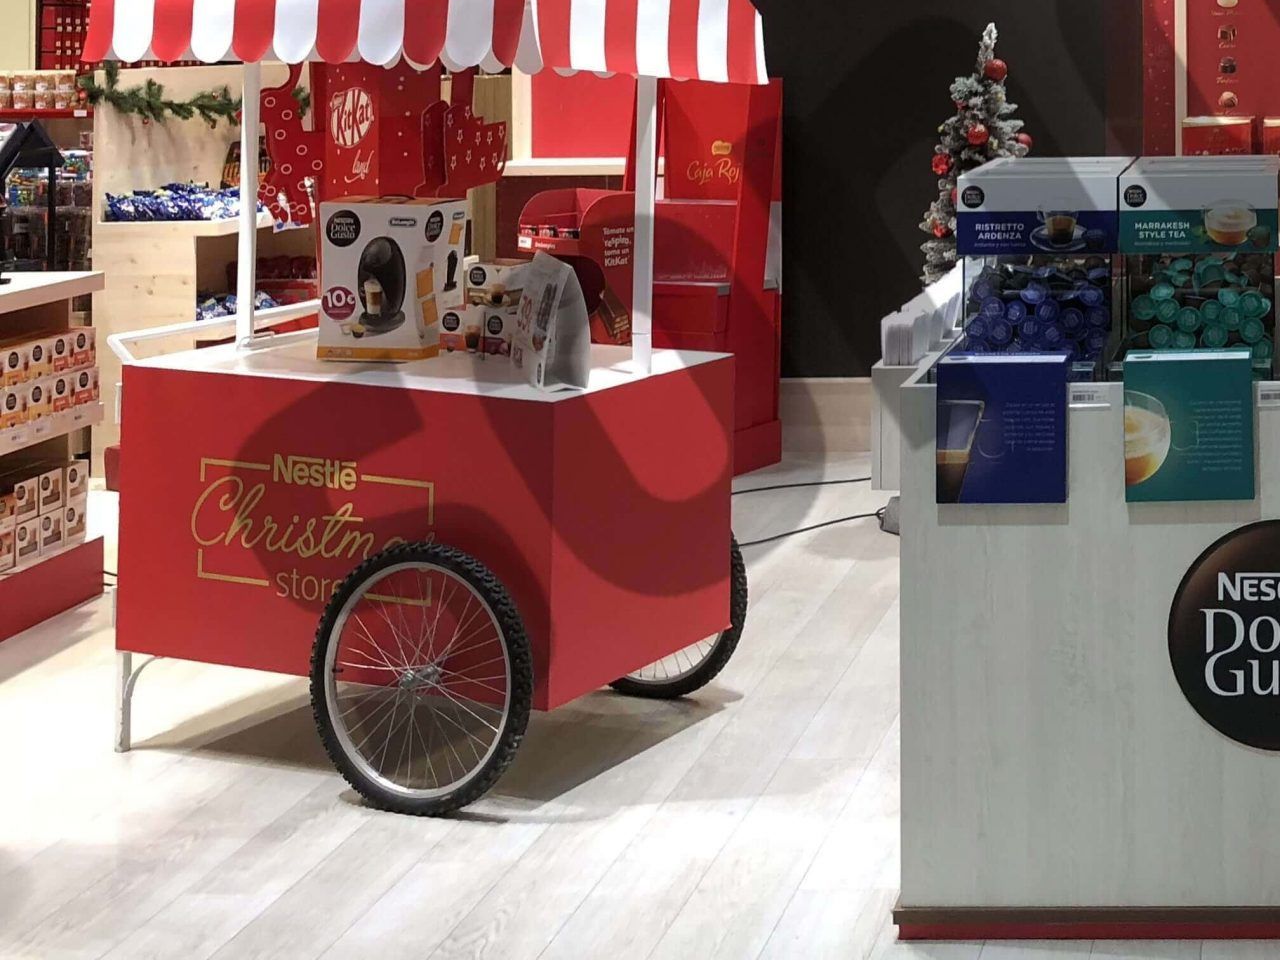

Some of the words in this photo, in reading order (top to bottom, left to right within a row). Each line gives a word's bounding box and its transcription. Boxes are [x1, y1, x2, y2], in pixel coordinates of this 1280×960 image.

[335, 89, 370, 146] KitKat
[686, 160, 714, 186] Caja
[714, 157, 740, 186] Roj
[975, 223, 1025, 232] RISTRETTO
[1134, 221, 1190, 230] MARRAKESH
[1138, 230, 1166, 239] STYLE
[1168, 230, 1186, 239] TEA
[977, 232, 1022, 240] ARDENZA
[273, 453, 357, 491] Nestlé
[190, 475, 435, 561] Christm
